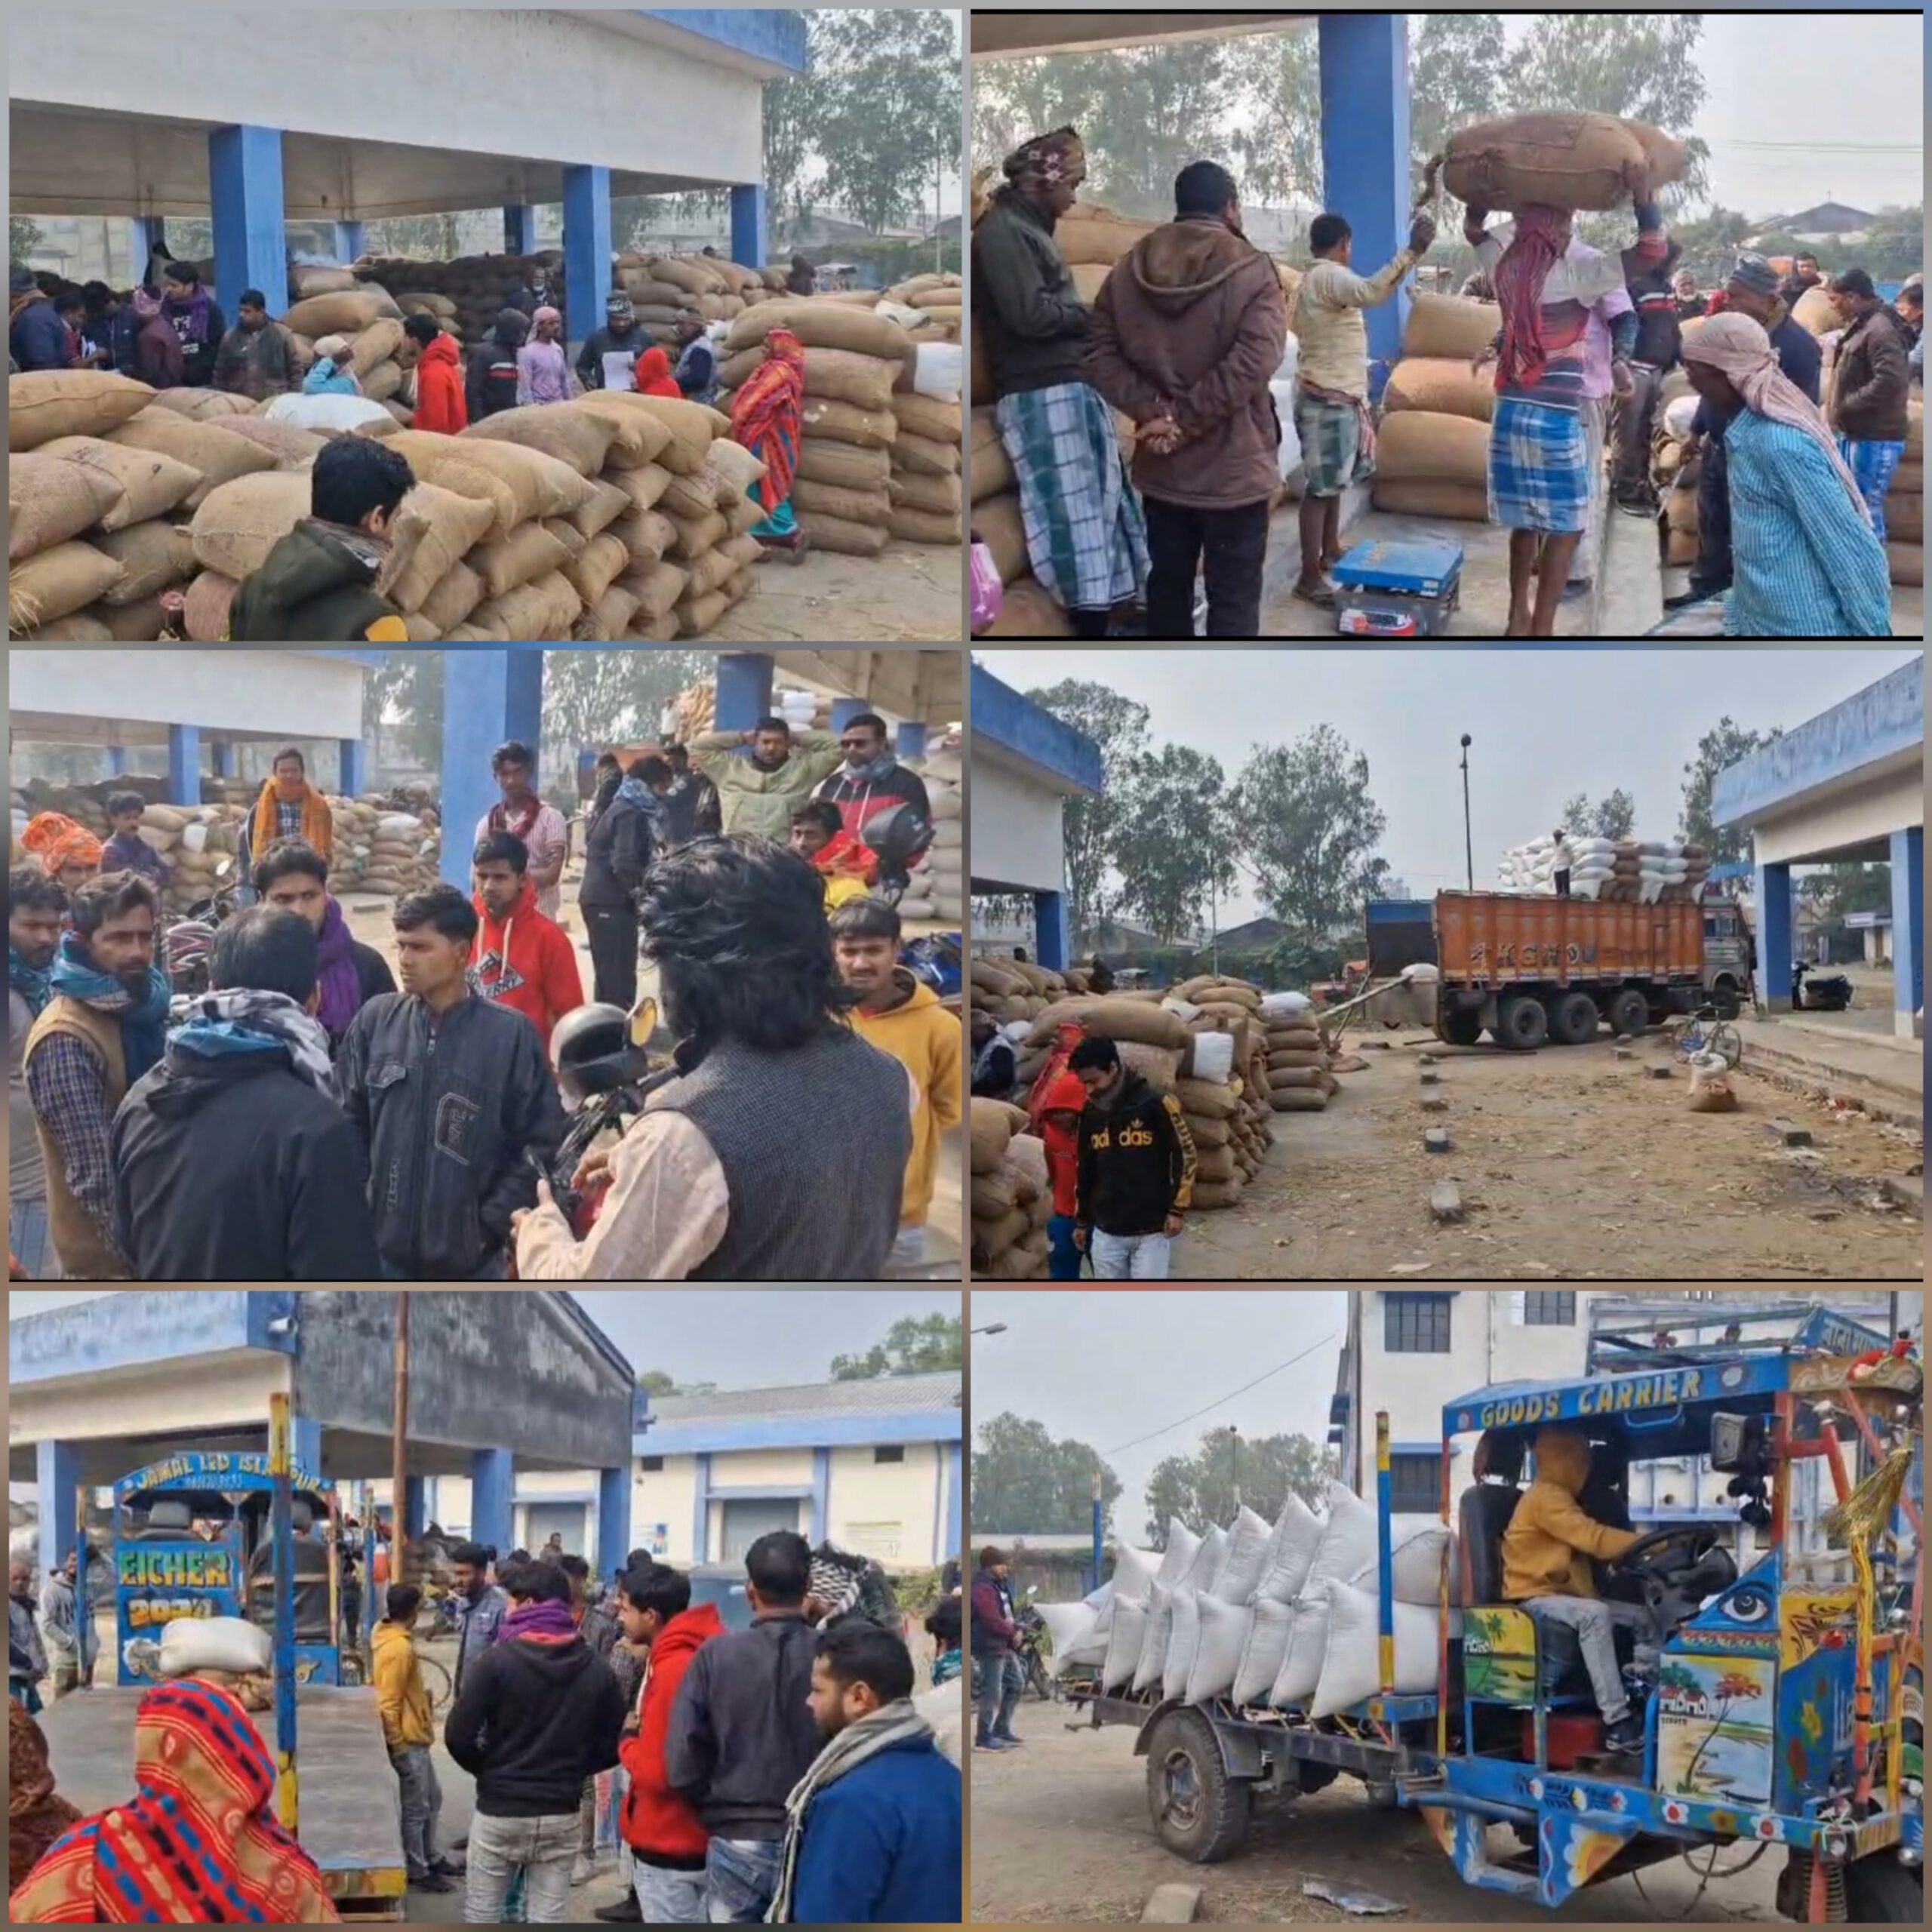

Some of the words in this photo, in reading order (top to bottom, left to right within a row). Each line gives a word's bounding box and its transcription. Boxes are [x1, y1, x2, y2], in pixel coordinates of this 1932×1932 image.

[1481, 1392, 1558, 1427] GOODS
[1579, 1370, 1700, 1414] CARRIER
[238, 1454, 321, 1492] ISLAPUR
[118, 1551, 229, 1587] EICHER
